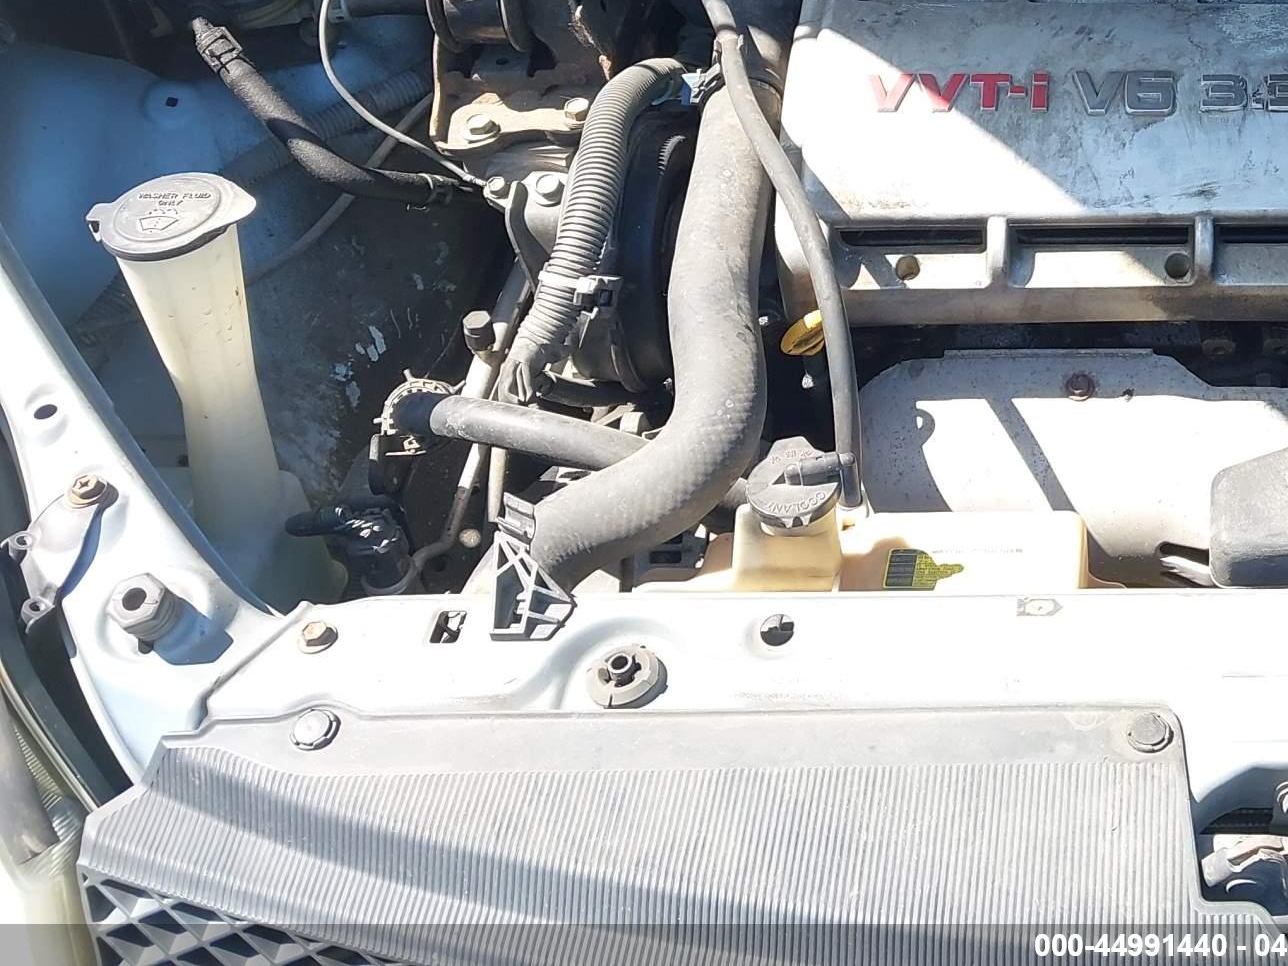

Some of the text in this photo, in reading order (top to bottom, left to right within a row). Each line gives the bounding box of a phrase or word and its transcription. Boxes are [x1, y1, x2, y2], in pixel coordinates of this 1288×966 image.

[868, 71, 1050, 113] VVT-i
[1071, 70, 1177, 117] V6
[767, 491, 826, 514] COOLANT
